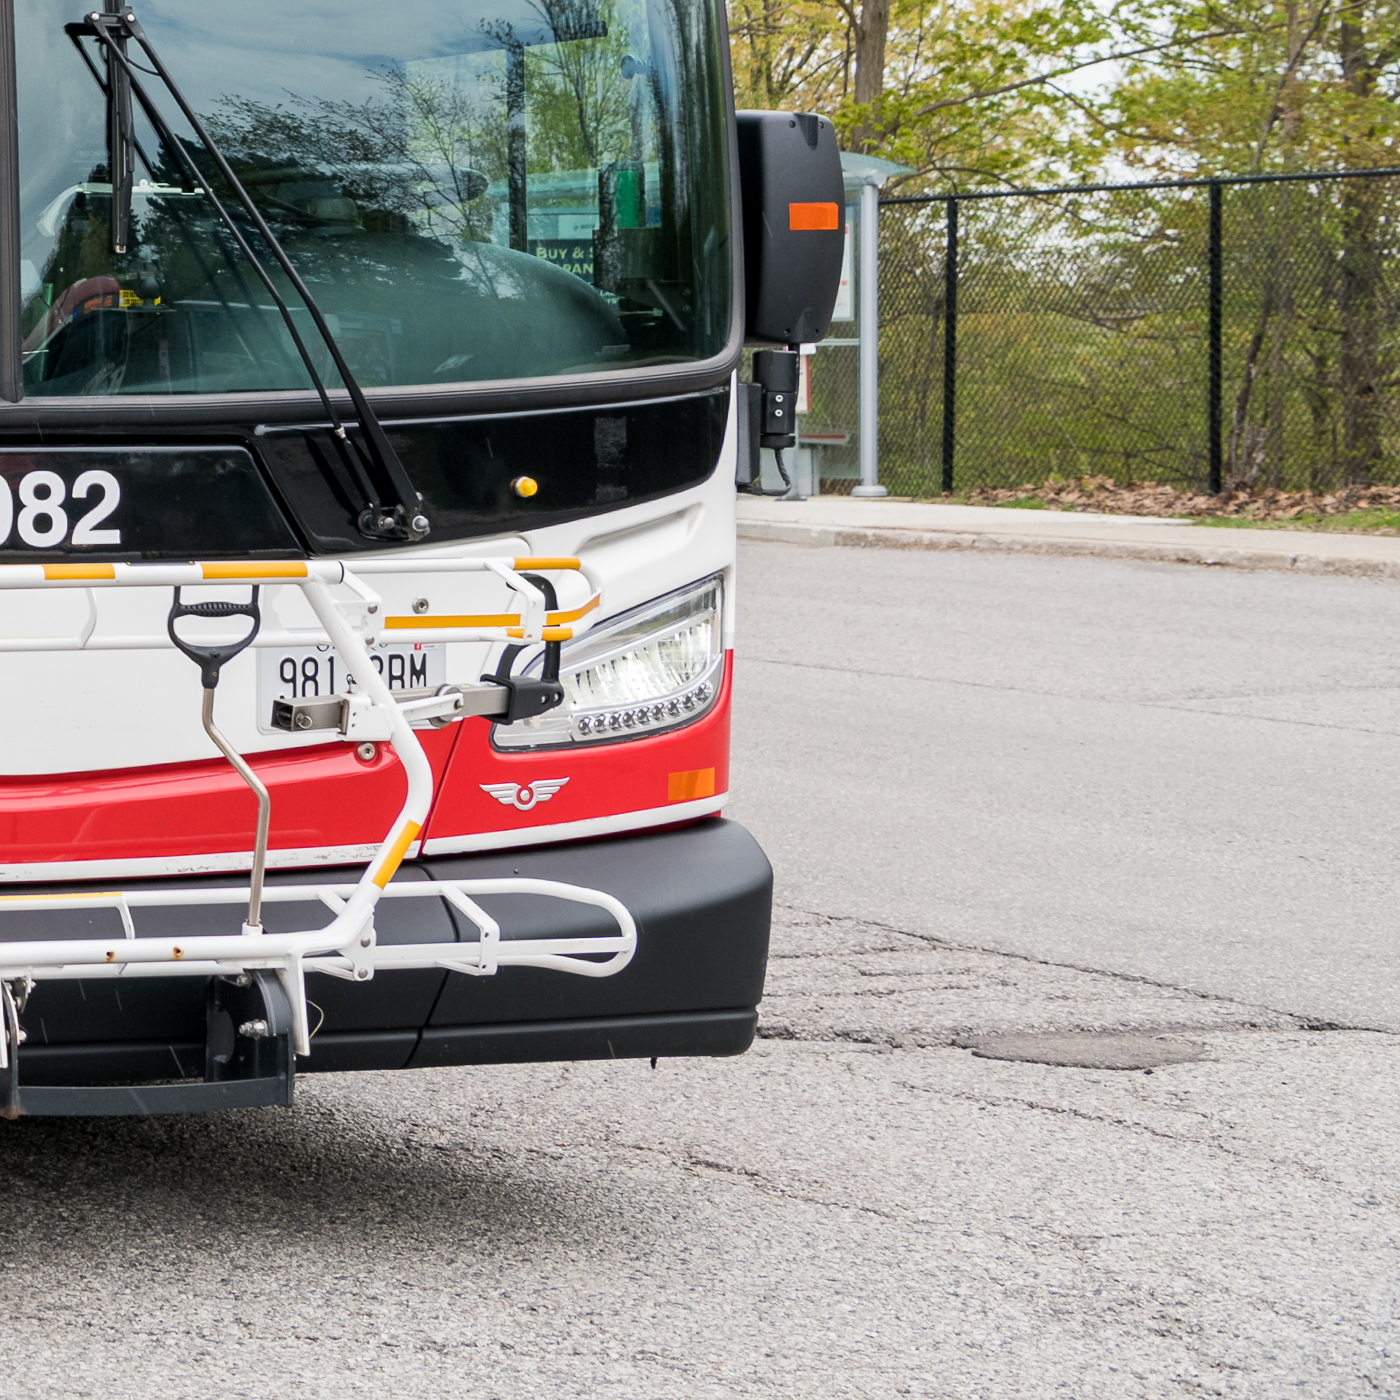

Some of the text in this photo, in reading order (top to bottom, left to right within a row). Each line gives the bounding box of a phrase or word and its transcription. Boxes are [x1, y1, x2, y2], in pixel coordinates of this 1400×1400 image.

[536, 246, 568, 260] BUY
[572, 246, 585, 260] &
[279, 656, 335, 699] 981
